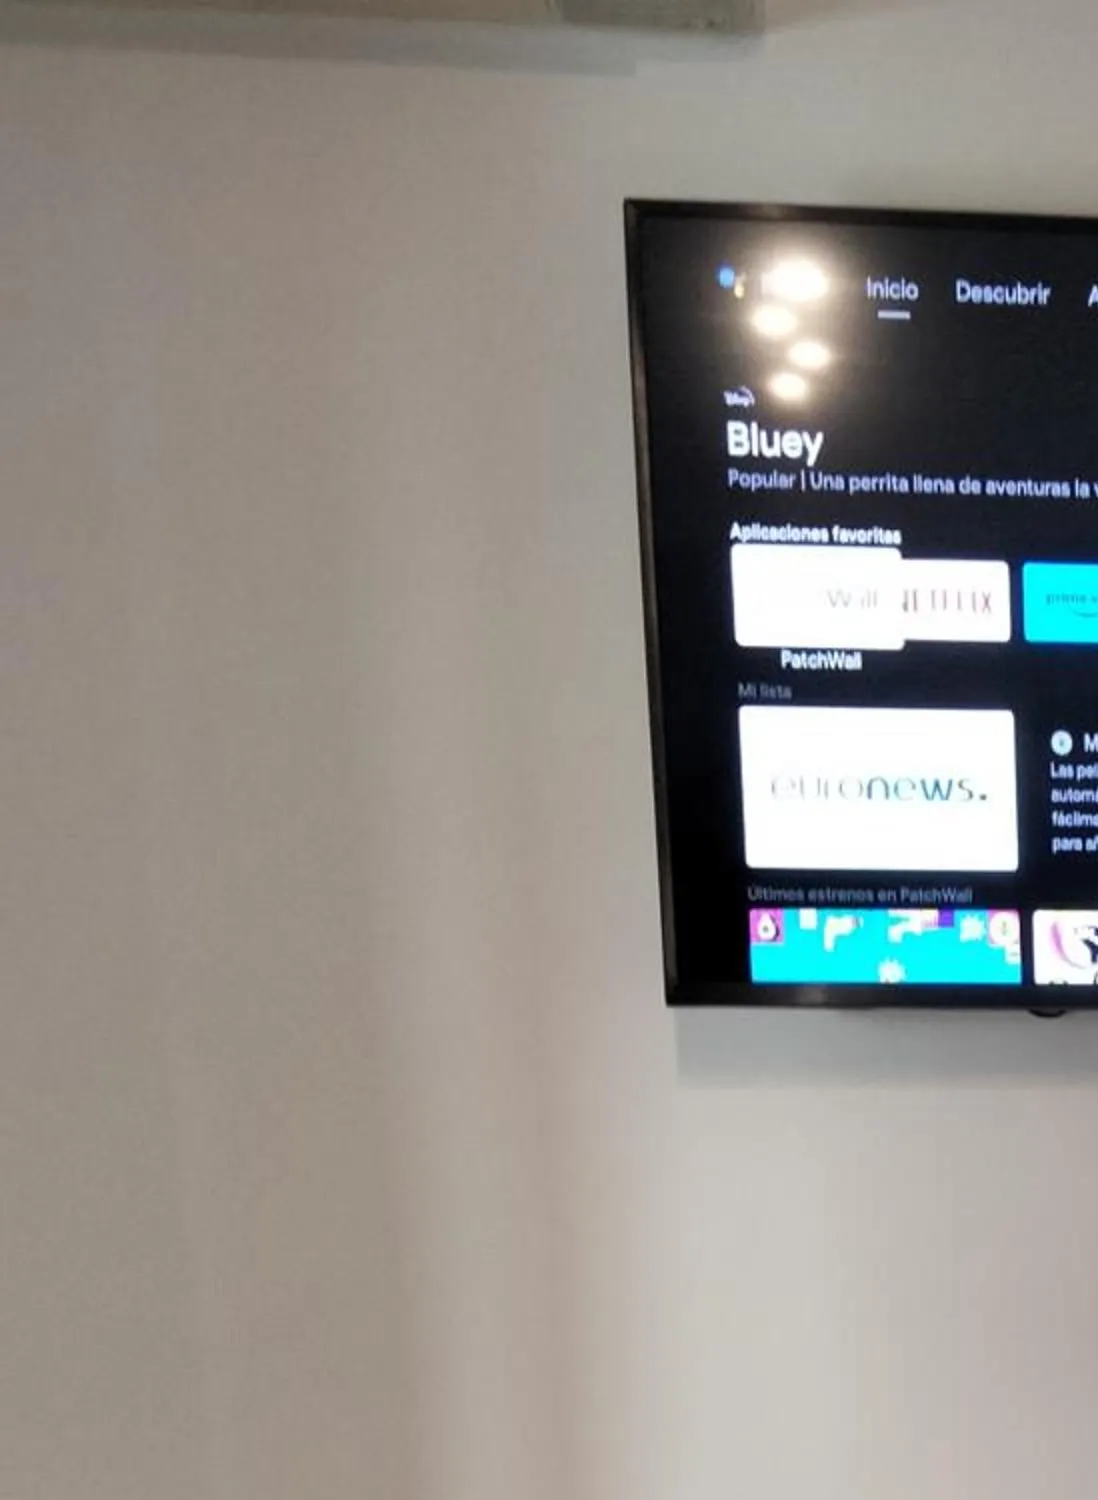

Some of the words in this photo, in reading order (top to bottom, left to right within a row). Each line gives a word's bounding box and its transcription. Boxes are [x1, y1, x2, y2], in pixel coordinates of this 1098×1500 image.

[866, 275, 919, 300] Inicio
[956, 279, 1051, 305] Descubrir
[727, 420, 823, 467] Bluey
[728, 468, 796, 492] Popular
[810, 471, 844, 491] Una
[850, 474, 909, 496] perrita
[913, 474, 954, 495] llena
[959, 475, 981, 495] de
[985, 478, 1071, 498] aventuras
[1074, 478, 1090, 498] la
[730, 521, 829, 543] Aplicaciones
[831, 525, 902, 545] favoritas
[781, 649, 863, 671] PatchWall
[1050, 762, 1074, 780] Las
[1052, 836, 1083, 855] para
[807, 885, 873, 904] estrenos
[877, 889, 898, 904] en
[900, 886, 973, 905] PatchWall
